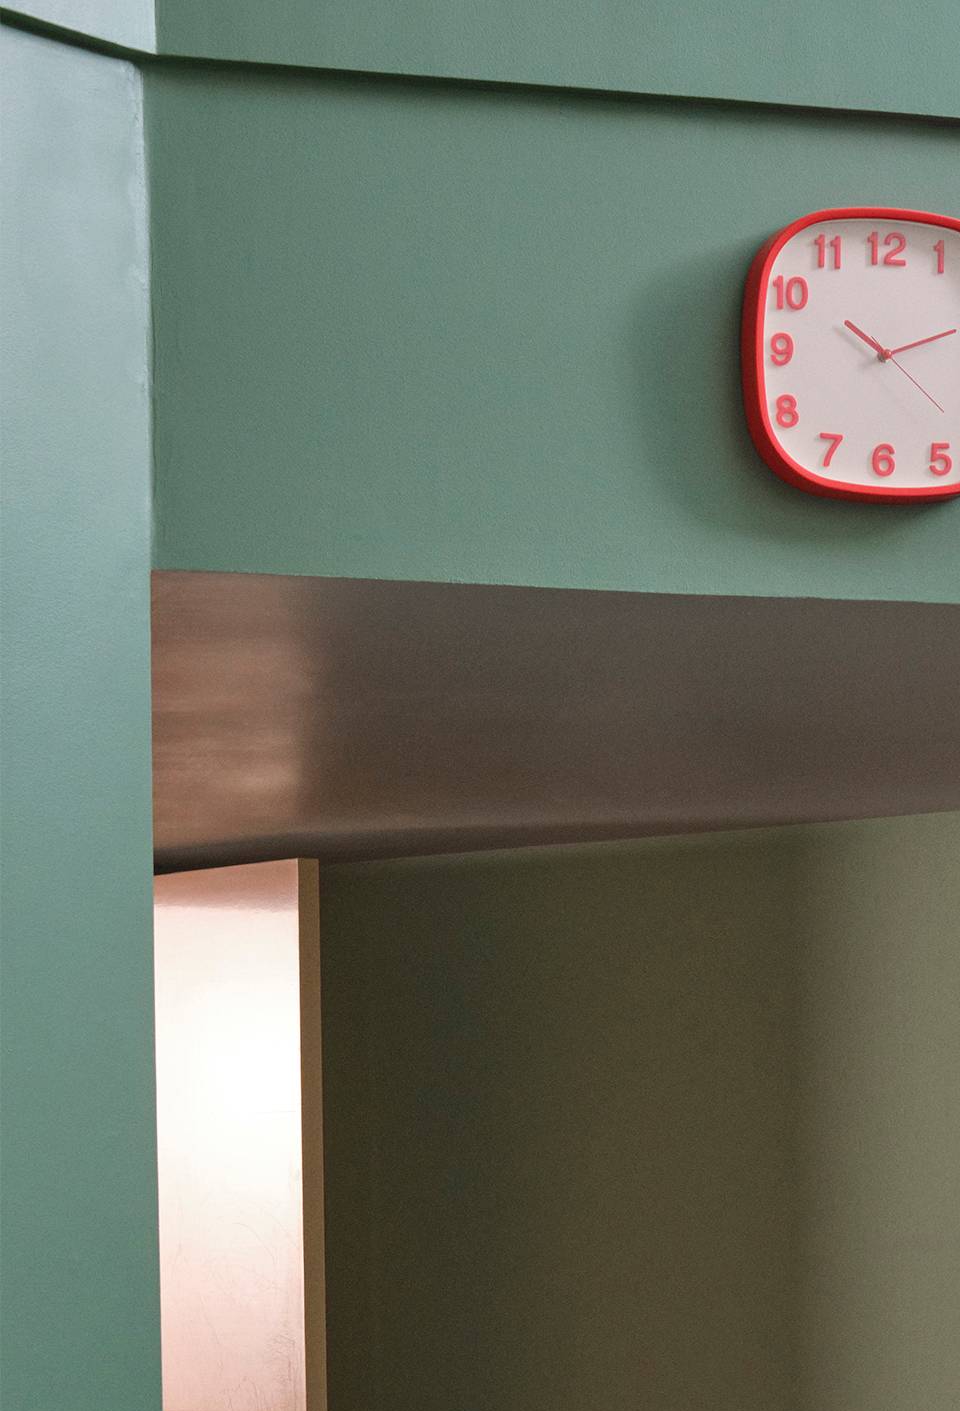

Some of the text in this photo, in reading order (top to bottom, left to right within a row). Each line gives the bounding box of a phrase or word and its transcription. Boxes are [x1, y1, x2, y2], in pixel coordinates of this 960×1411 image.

[814, 234, 842, 269] 11
[867, 232, 907, 267] 12
[933, 240, 944, 273] 1
[772, 274, 808, 310] 10
[770, 332, 795, 367] 9
[775, 393, 800, 428] 8
[819, 432, 844, 468] 7
[871, 443, 896, 477] 6
[928, 441, 953, 476] 5
